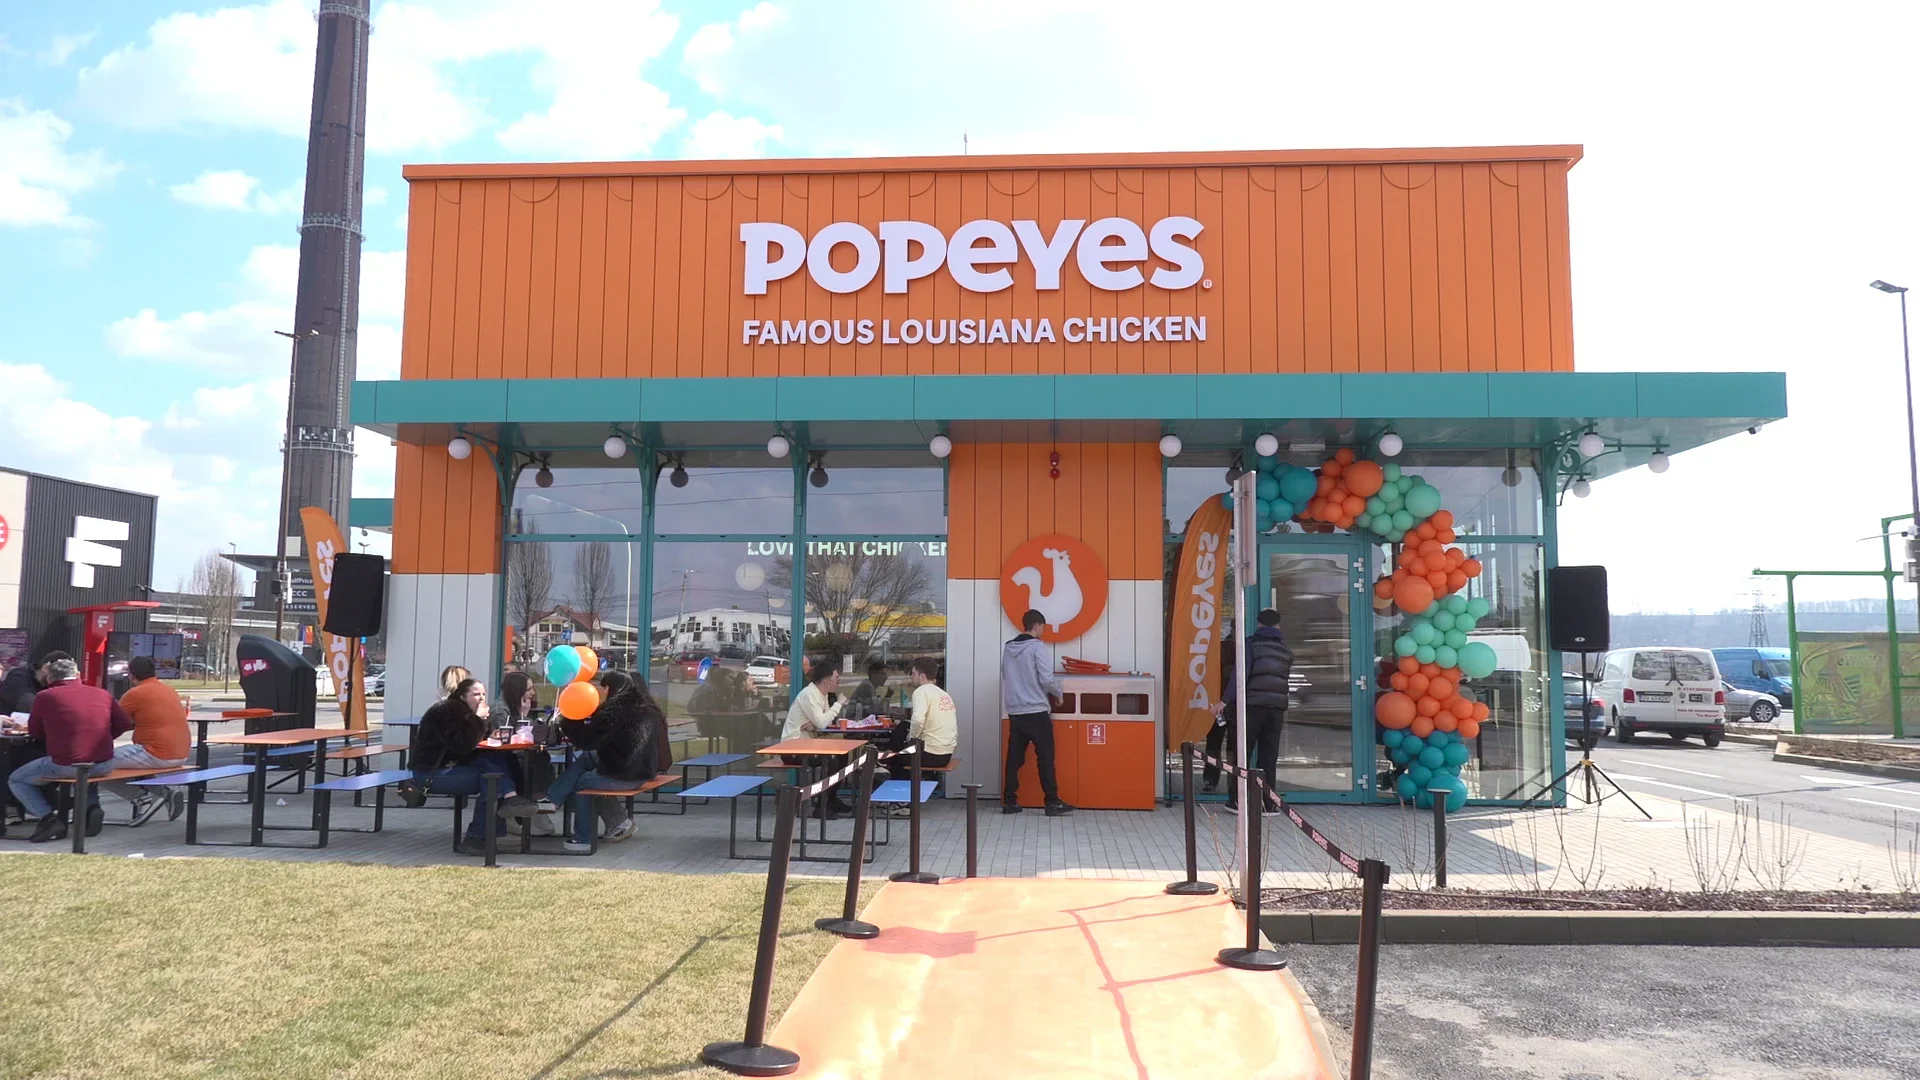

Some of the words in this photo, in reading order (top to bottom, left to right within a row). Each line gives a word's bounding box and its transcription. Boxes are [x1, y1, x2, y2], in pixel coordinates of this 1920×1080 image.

[742, 319, 875, 345] FAMOUS
[882, 318, 1056, 344] LOUISIANA
[1063, 316, 1207, 342] CHICKEN
[805, 541, 860, 556] THAT
